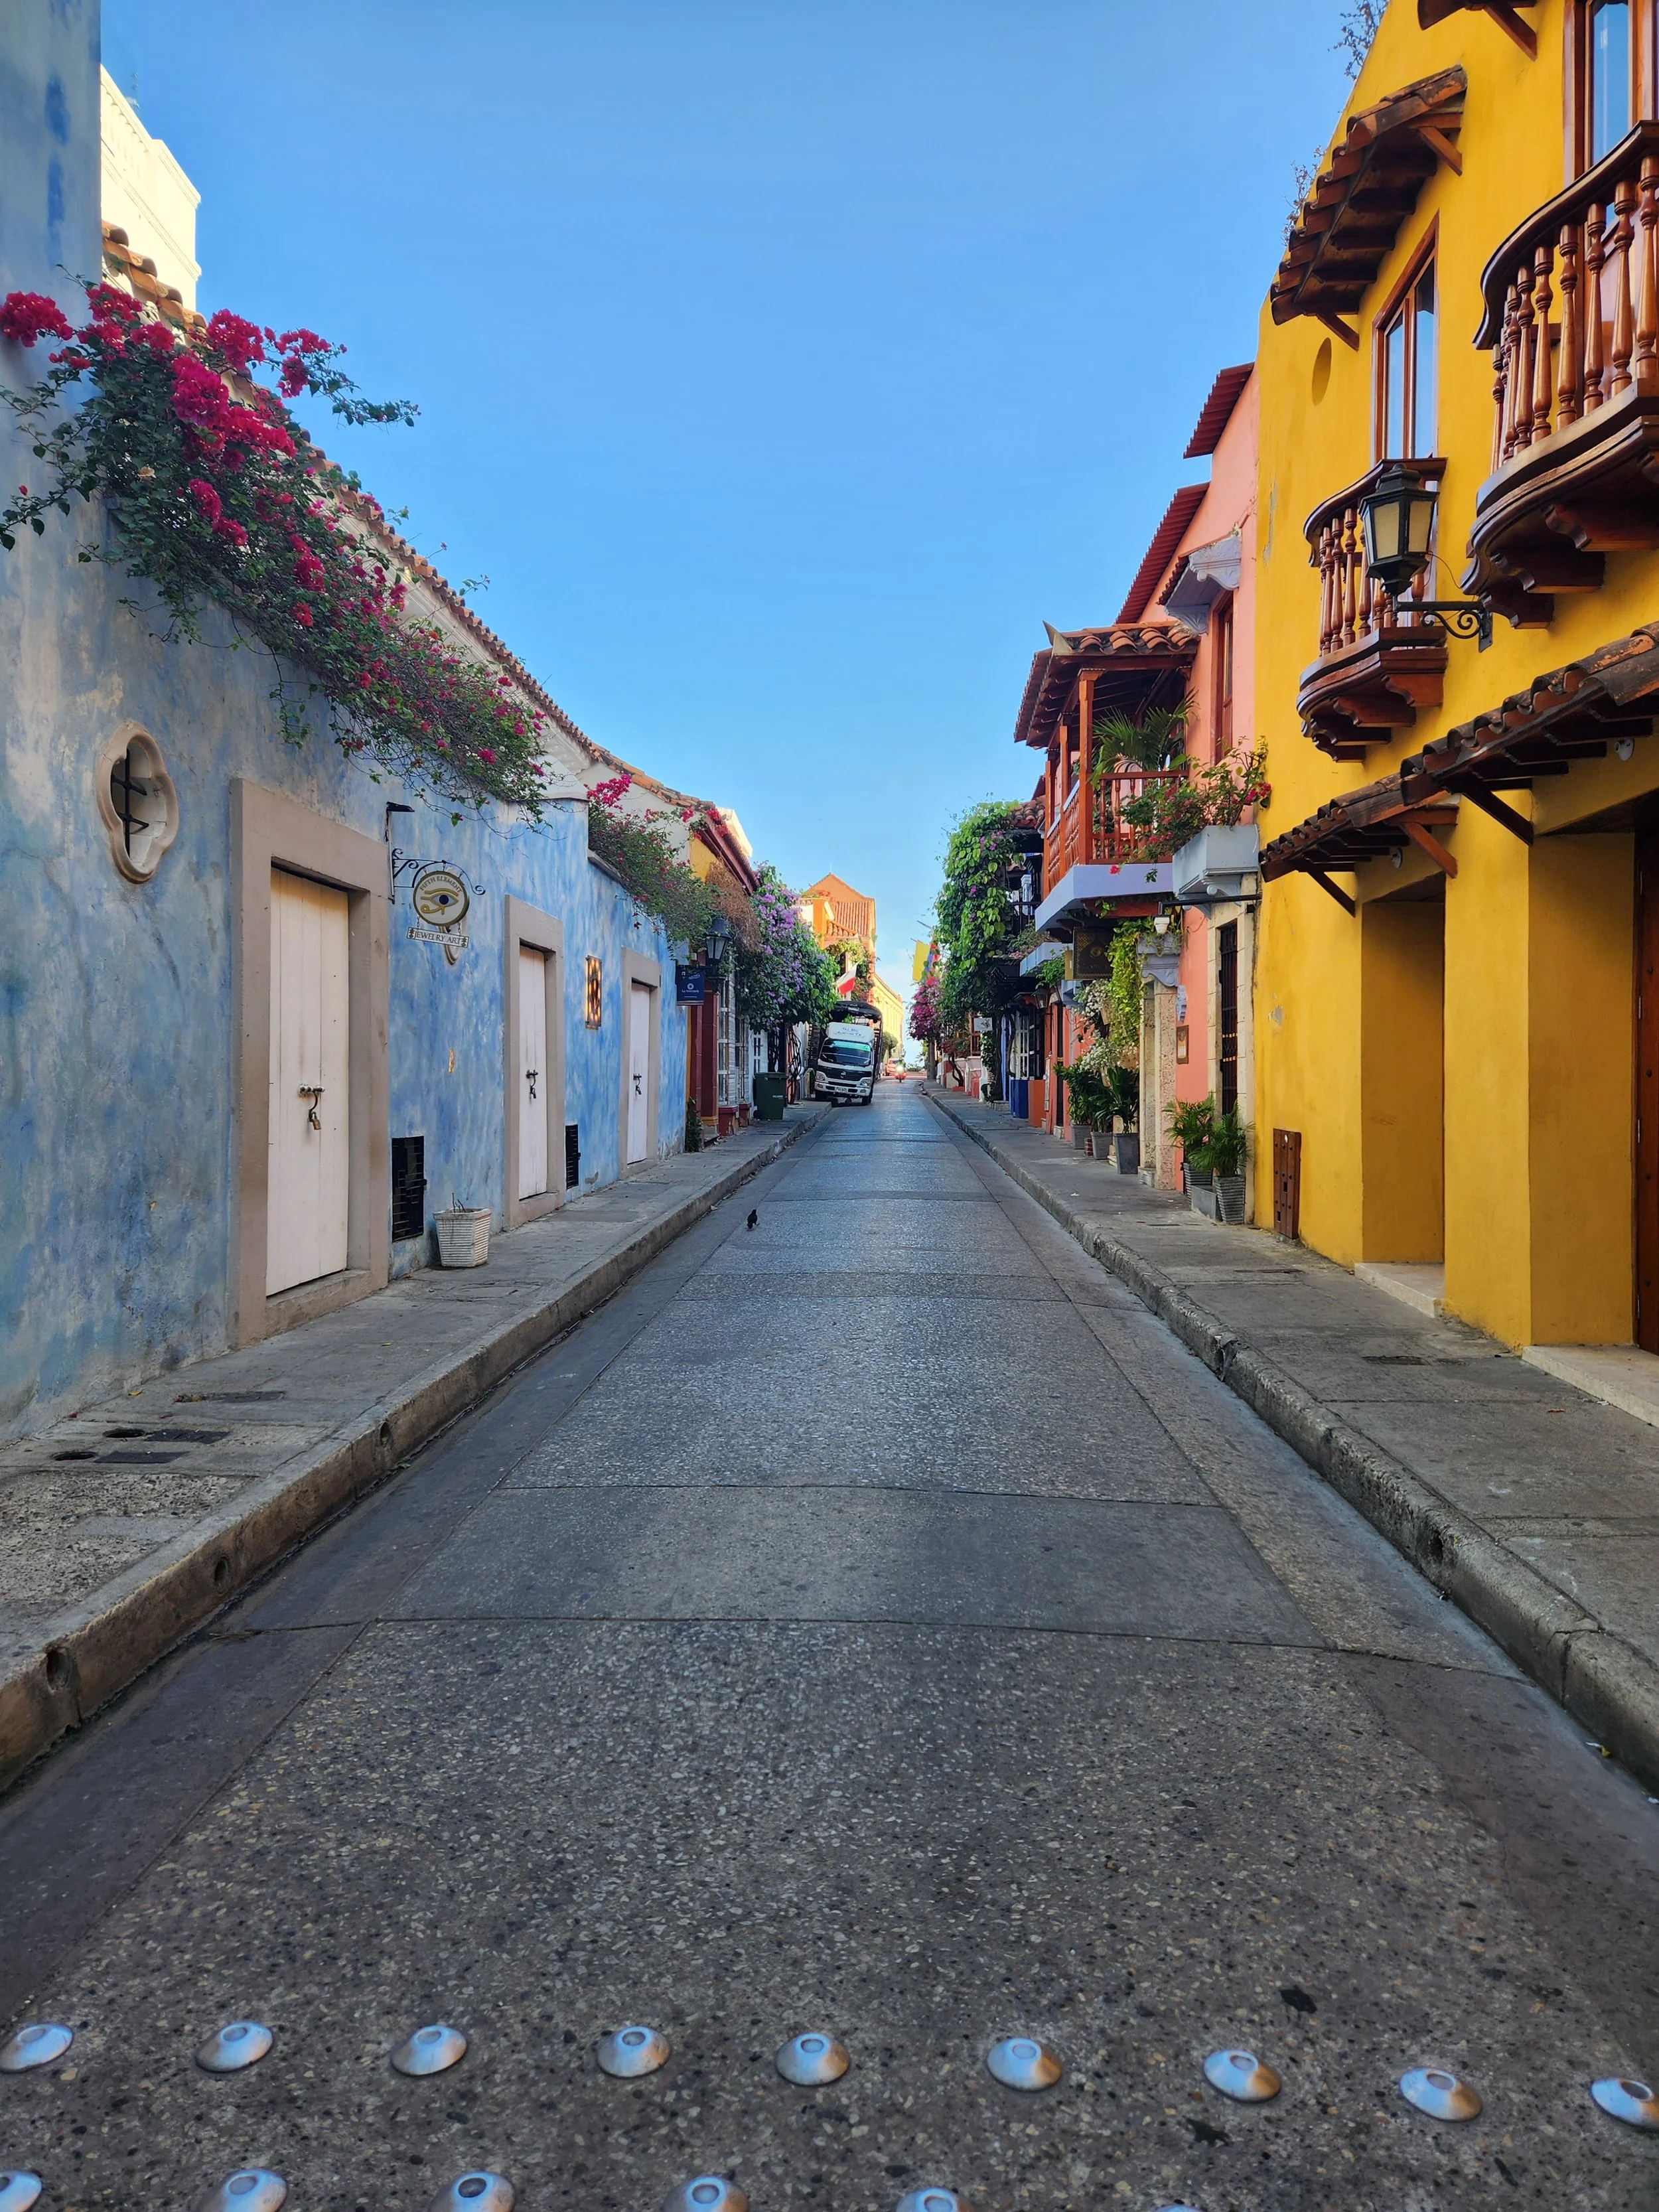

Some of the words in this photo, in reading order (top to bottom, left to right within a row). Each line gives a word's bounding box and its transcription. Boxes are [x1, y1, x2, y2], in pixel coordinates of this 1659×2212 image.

[419, 876, 436, 891] FIFTH
[437, 875, 463, 893] ELEMENT
[414, 930, 445, 941] JEWELRY
[447, 936, 461, 944] ART
